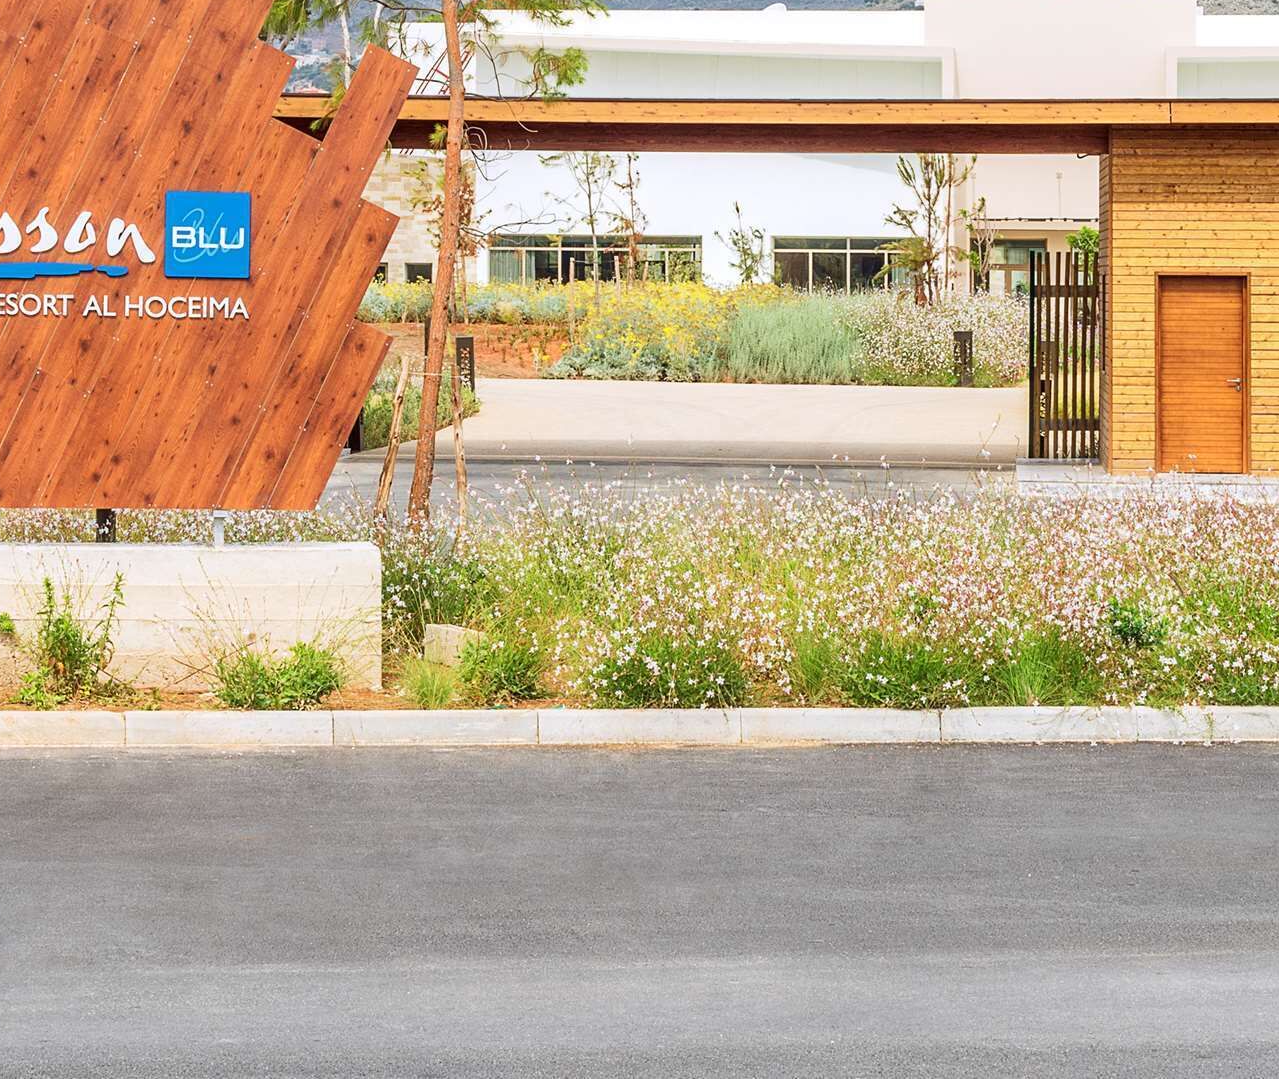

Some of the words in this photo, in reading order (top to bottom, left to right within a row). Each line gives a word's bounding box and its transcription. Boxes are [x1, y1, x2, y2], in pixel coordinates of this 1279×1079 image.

[171, 226, 245, 249] BLU
[82, 294, 117, 317] AL
[124, 295, 250, 319] HOCEIMA
